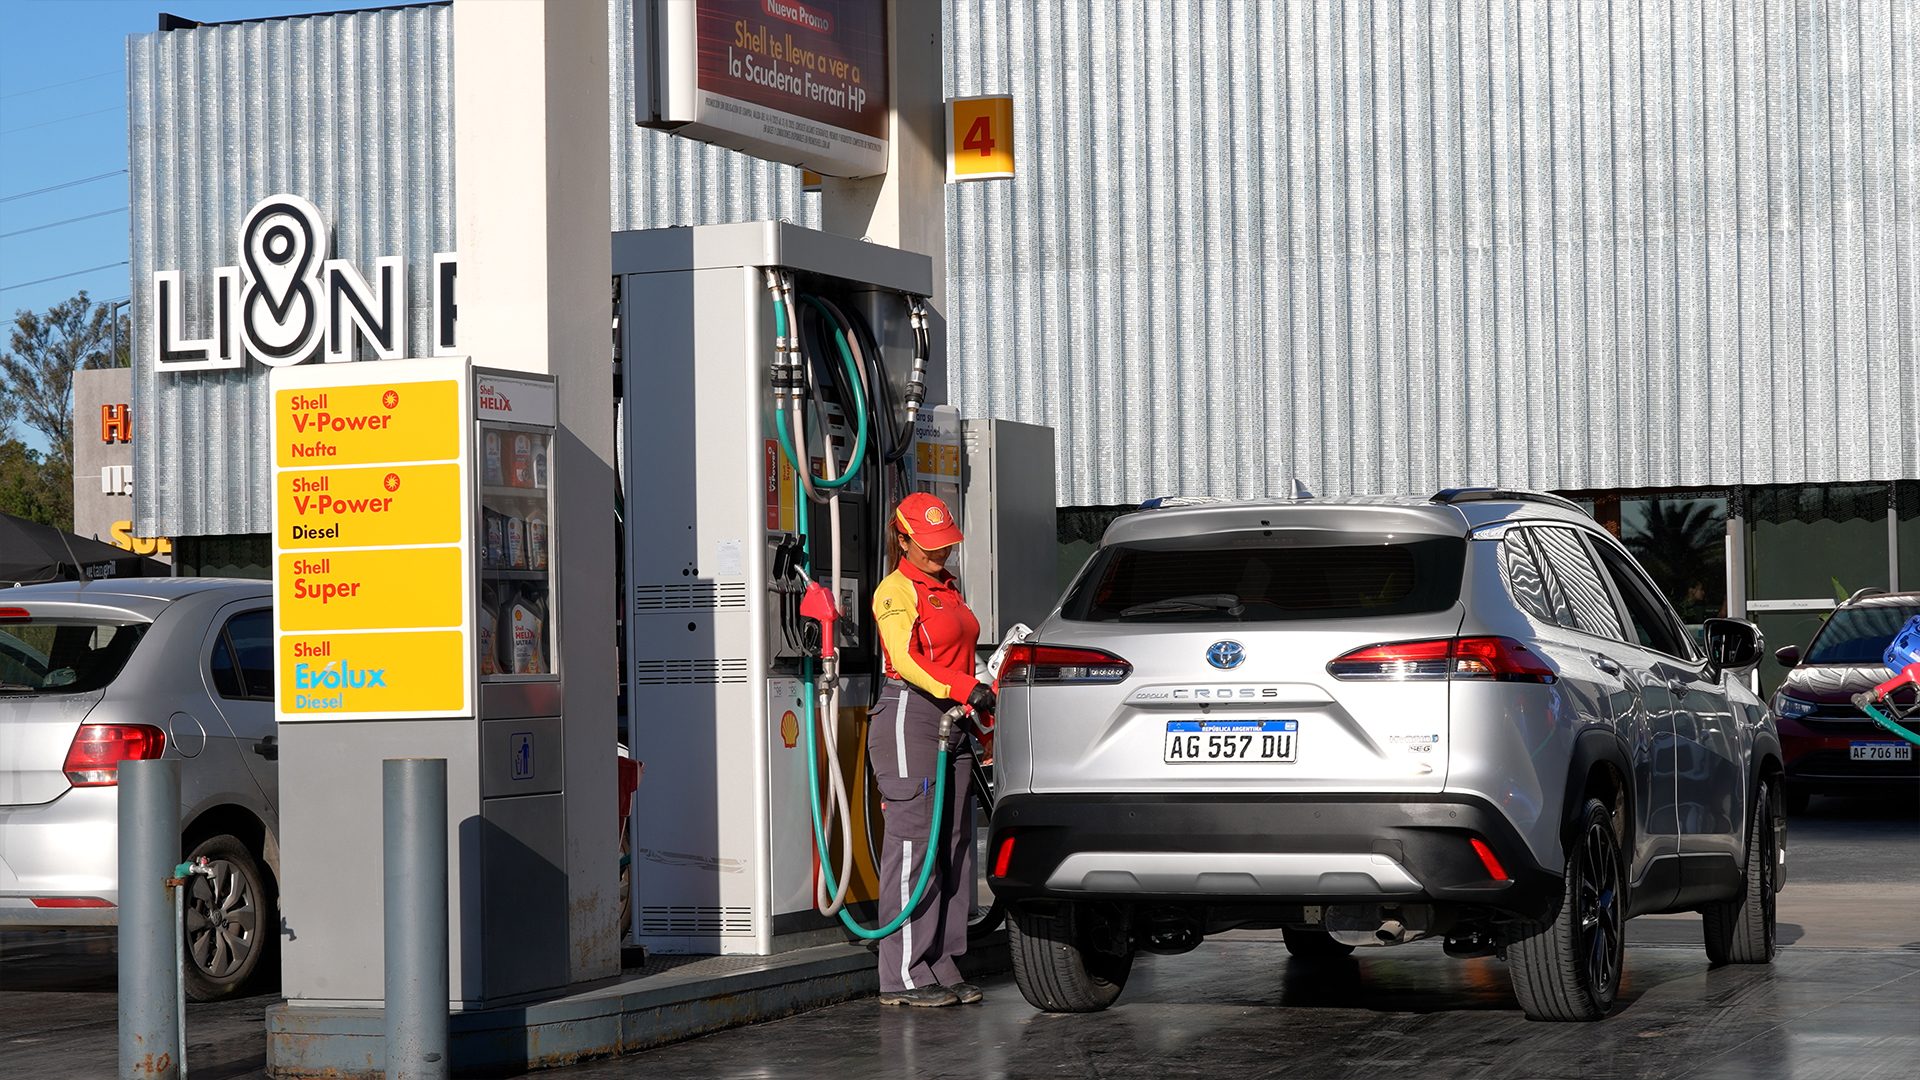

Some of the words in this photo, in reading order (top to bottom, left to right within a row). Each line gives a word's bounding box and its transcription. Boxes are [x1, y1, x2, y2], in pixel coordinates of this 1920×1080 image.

[767, 0, 798, 21] Nueva
[800, 6, 829, 31] Promo
[735, 20, 767, 54] Shell
[769, 35, 783, 58] te
[785, 33, 815, 70] lleva
[817, 56, 827, 73] a
[829, 58, 849, 80] ver
[852, 66, 861, 84] a
[728, 46, 742, 78] la
[745, 54, 802, 96] Scuderia
[804, 72, 846, 109] Ferrari
[848, 85, 866, 113] HP
[963, 116, 995, 157] 4
[480, 385, 495, 396] Shell
[291, 393, 328, 411] Shell
[480, 395, 513, 412] HELIX
[292, 412, 392, 434] V-Power
[915, 426, 941, 439] eguridad
[291, 441, 337, 458] Nafta
[292, 476, 329, 493] Shell
[293, 494, 393, 516] V-Power
[293, 523, 339, 540] Diesel
[293, 558, 330, 575] Shell
[294, 578, 361, 604] Super
[294, 641, 331, 657] Shell
[295, 692, 343, 709] Diesel
[1173, 688, 1278, 699] CROSS
[1170, 735, 1201, 759] AG
[1208, 735, 1253, 759] 557
[1261, 735, 1291, 758] DU
[1853, 747, 1867, 758] AF
[1870, 747, 1892, 759] 706
[1894, 747, 1909, 758] HH
